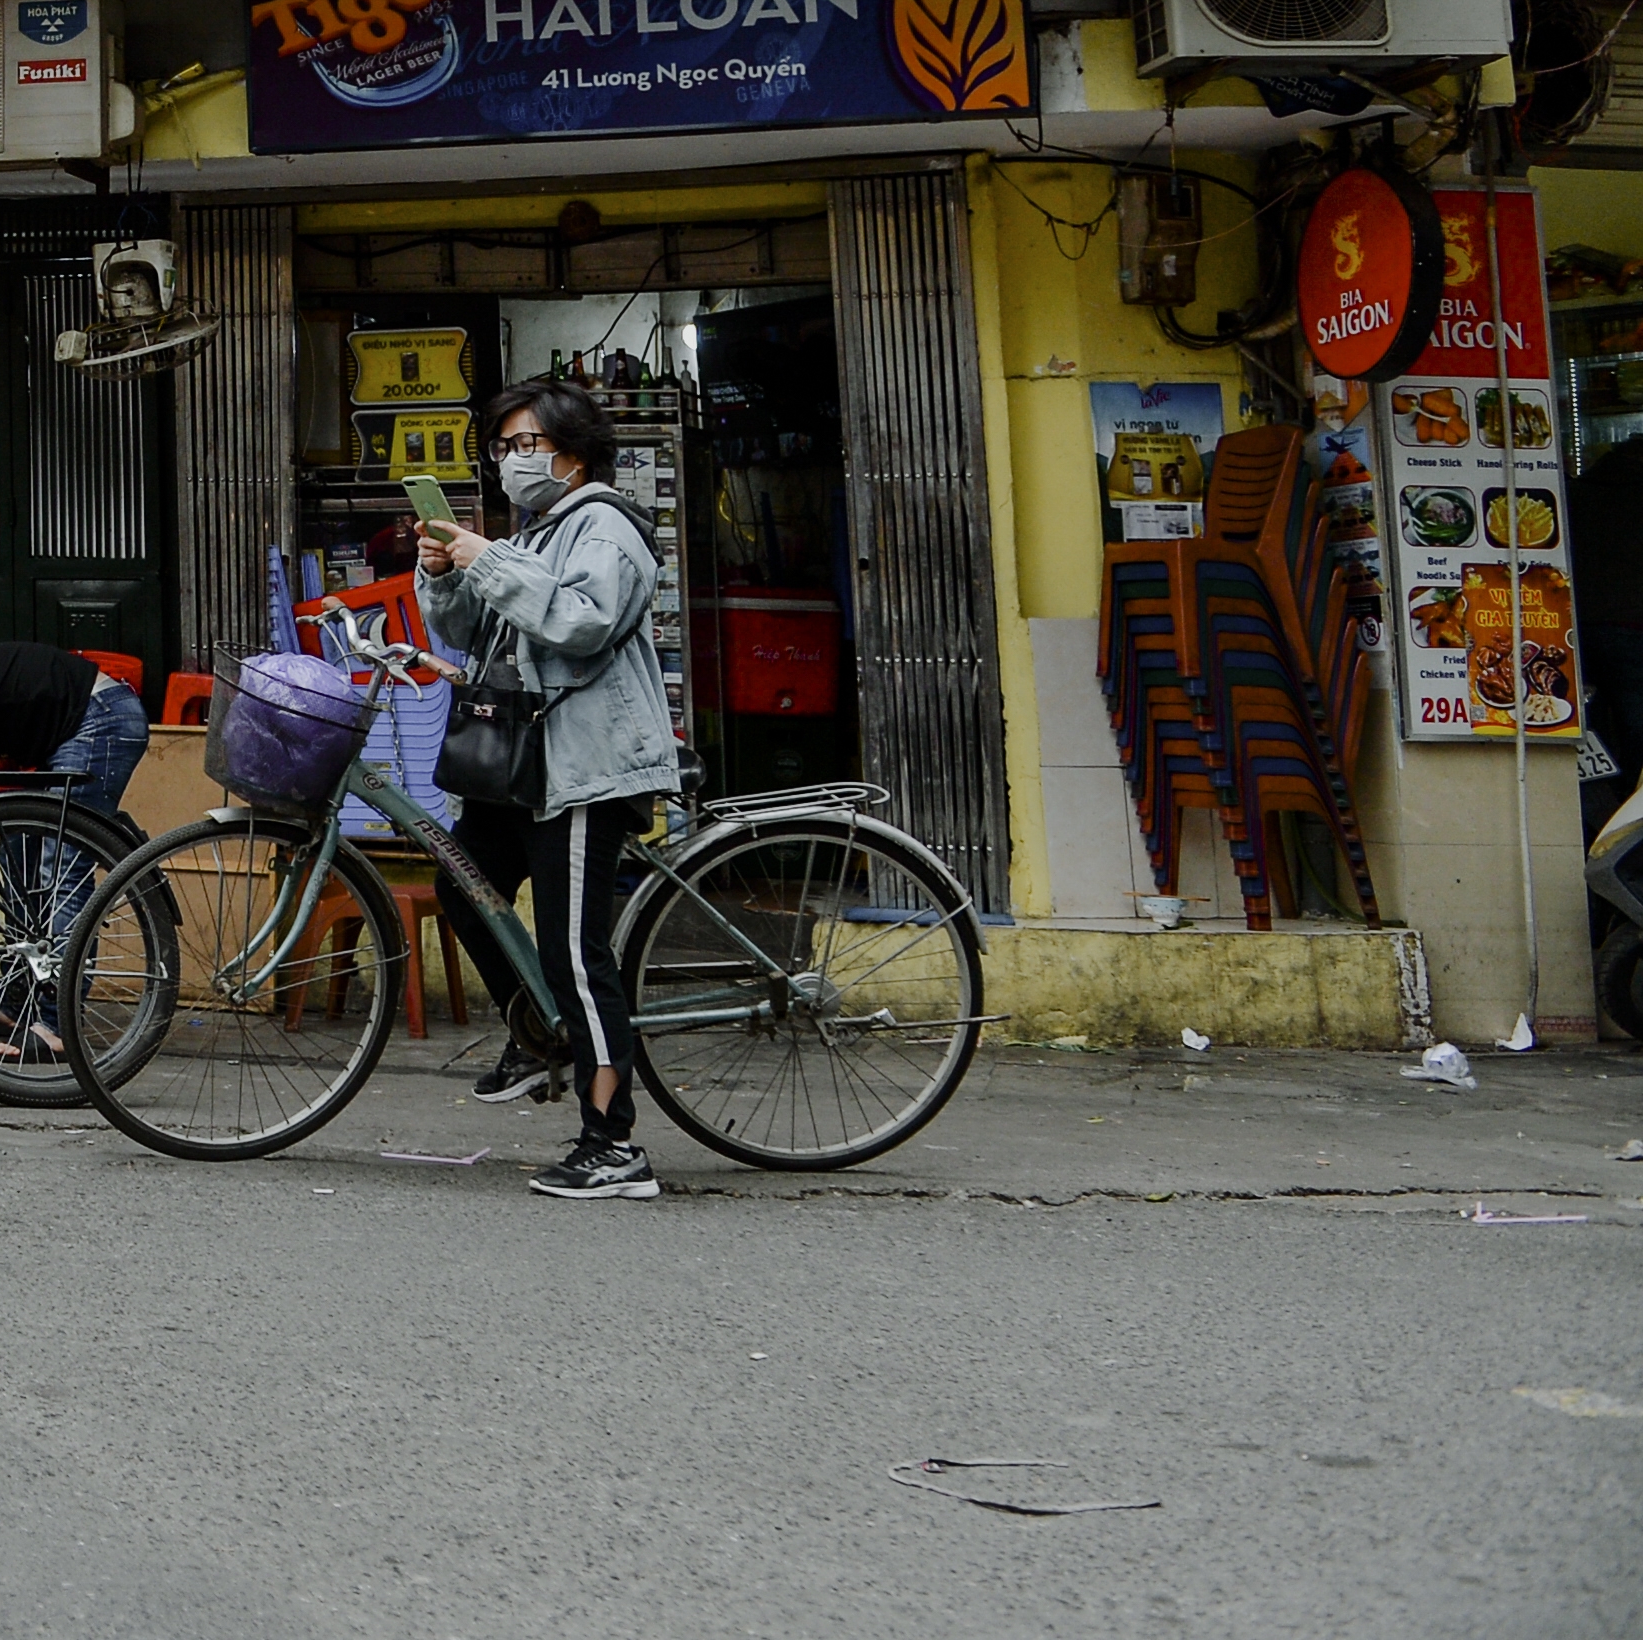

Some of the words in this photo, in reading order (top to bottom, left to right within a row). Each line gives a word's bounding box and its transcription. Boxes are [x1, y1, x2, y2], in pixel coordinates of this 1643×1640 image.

[296, 38, 345, 64] SINCE
[18, 64, 82, 80] Funiki
[356, 63, 404, 87] LAGER
[407, 50, 443, 70] BEER
[541, 68, 570, 89] 41
[576, 68, 652, 92] Lương
[656, 62, 719, 91] Ngọc
[1340, 289, 1363, 310] BIA
[1439, 298, 1479, 317] BIA
[1316, 299, 1391, 345] SAIGON
[1429, 319, 1525, 351] AIGON
[1406, 457, 1438, 467] Cheese
[1440, 458, 1463, 468] Stick
[1536, 460, 1559, 471] Rolls
[1427, 556, 1448, 566] Beef
[1417, 571, 1447, 580] Noodle
[1443, 655, 1466, 664] Fried
[1420, 670, 1455, 679] Chicken
[1421, 697, 1469, 723] 29A
[413, 819, 482, 881] ASAMA
